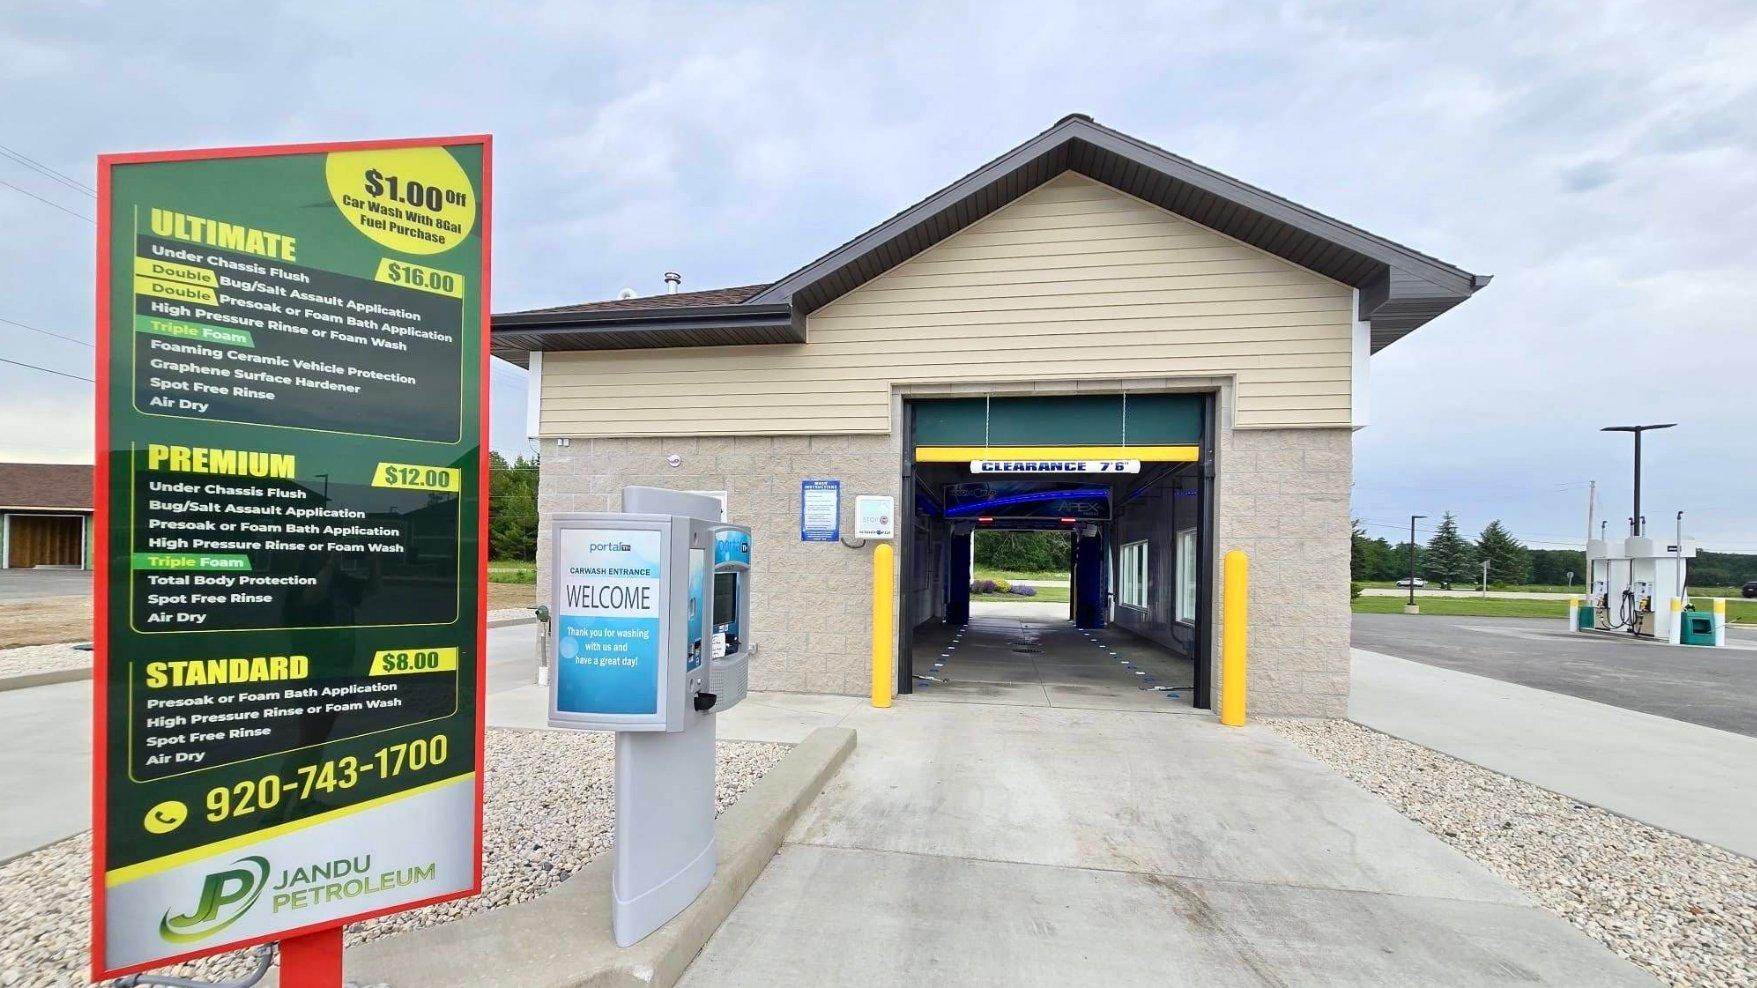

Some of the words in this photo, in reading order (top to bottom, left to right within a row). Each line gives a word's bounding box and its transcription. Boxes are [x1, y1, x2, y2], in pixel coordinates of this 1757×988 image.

[365, 168, 443, 212] $1.00
[446, 190, 466, 207] Off
[342, 194, 365, 210] Car
[368, 200, 402, 220] Wash
[405, 210, 434, 227] With
[436, 218, 462, 234] 8Gal
[151, 208, 296, 262] ULTIMATE
[360, 214, 386, 230] Fuel
[389, 221, 446, 244] Purchase
[152, 244, 204, 262] Under
[206, 255, 266, 275] Chassis
[270, 267, 310, 284] Flush
[388, 262, 454, 292] $16.00
[152, 264, 211, 282] Double
[220, 276, 287, 297] Bug/Salt
[290, 289, 344, 307] Assault
[346, 300, 422, 322] Application
[152, 283, 211, 301] Double
[220, 294, 282, 314] Presoak
[284, 307, 301, 316] or
[304, 308, 344, 324] Foam
[346, 316, 379, 330] Bath
[381, 322, 453, 343] Application
[150, 320, 198, 336] Triple
[202, 328, 247, 343] Foam
[152, 301, 191, 317] High
[194, 308, 264, 328] Pressure
[268, 320, 308, 335] Rinse
[312, 328, 327, 338] or
[330, 330, 368, 346] Foam
[370, 336, 408, 352] Wash
[150, 339, 223, 360] Foaming
[226, 350, 290, 367] Ceramic
[292, 358, 345, 375] Vehicle
[348, 366, 416, 385] Protection
[150, 358, 231, 378] Graphene
[234, 368, 292, 385] Surface
[295, 376, 361, 394] Hardener
[150, 377, 190, 390] Spot
[193, 382, 229, 394] Free
[233, 386, 276, 400] Rinse
[150, 396, 176, 408] Air
[179, 400, 209, 413] Dry
[148, 444, 296, 480] PREMIUM
[982, 462, 1087, 472] CLEARANCE
[385, 465, 450, 488] $12.00
[150, 482, 201, 493] Under
[204, 484, 264, 496] Chassis
[267, 488, 306, 499] Flush
[150, 500, 221, 513] Bug/Salt
[224, 503, 282, 515] Assault
[286, 506, 366, 518] Application
[149, 519, 216, 531] Presoak
[220, 523, 236, 531] or
[240, 522, 282, 533] Foam
[286, 524, 320, 534] Bath
[322, 525, 400, 537] Application
[148, 537, 188, 550] High
[192, 539, 262, 550] Pressure
[264, 540, 306, 551] Rinse
[308, 544, 324, 552] or
[327, 542, 364, 552] Foam
[368, 543, 404, 553] Wash
[148, 556, 196, 568] Triple
[200, 558, 244, 568] Foam
[570, 567, 606, 575] CARWASH
[608, 568, 650, 576] ENTRANCE
[148, 575, 190, 586] Total
[194, 575, 236, 588] Body
[239, 575, 317, 586] Protection
[148, 594, 187, 606] Spot
[191, 594, 226, 604] Free
[230, 593, 273, 603] Rinse
[566, 584, 650, 610] WELCOME
[148, 612, 174, 622] Air
[176, 612, 207, 624] Dry
[568, 626, 588, 636] Thank
[590, 629, 602, 638] you
[604, 628, 614, 637] for
[616, 628, 650, 640] washing
[584, 642, 600, 651] with
[613, 643, 628, 652] and
[146, 655, 309, 688] STANDARD
[382, 652, 439, 672] $8.00
[576, 656, 592, 664] have
[600, 657, 620, 666] great
[622, 656, 638, 668] day!
[147, 695, 214, 709] Presoak
[218, 694, 234, 704] or
[238, 692, 280, 702] Foam
[284, 688, 318, 699] Bath
[322, 682, 398, 696] Application
[146, 716, 186, 728] High
[191, 710, 260, 724] Pressure
[264, 706, 304, 718] Rinse
[307, 705, 322, 714] or
[326, 702, 362, 712] Foam
[366, 698, 402, 708] Wash
[146, 734, 186, 748] Spot
[190, 732, 226, 743] Free
[230, 727, 272, 738] Rinse
[145, 754, 172, 766] Air
[176, 751, 206, 763] Dry
[206, 734, 448, 823] 920-743-1700
[272, 854, 371, 890] JANDU
[272, 862, 436, 914] PETROLEUM
